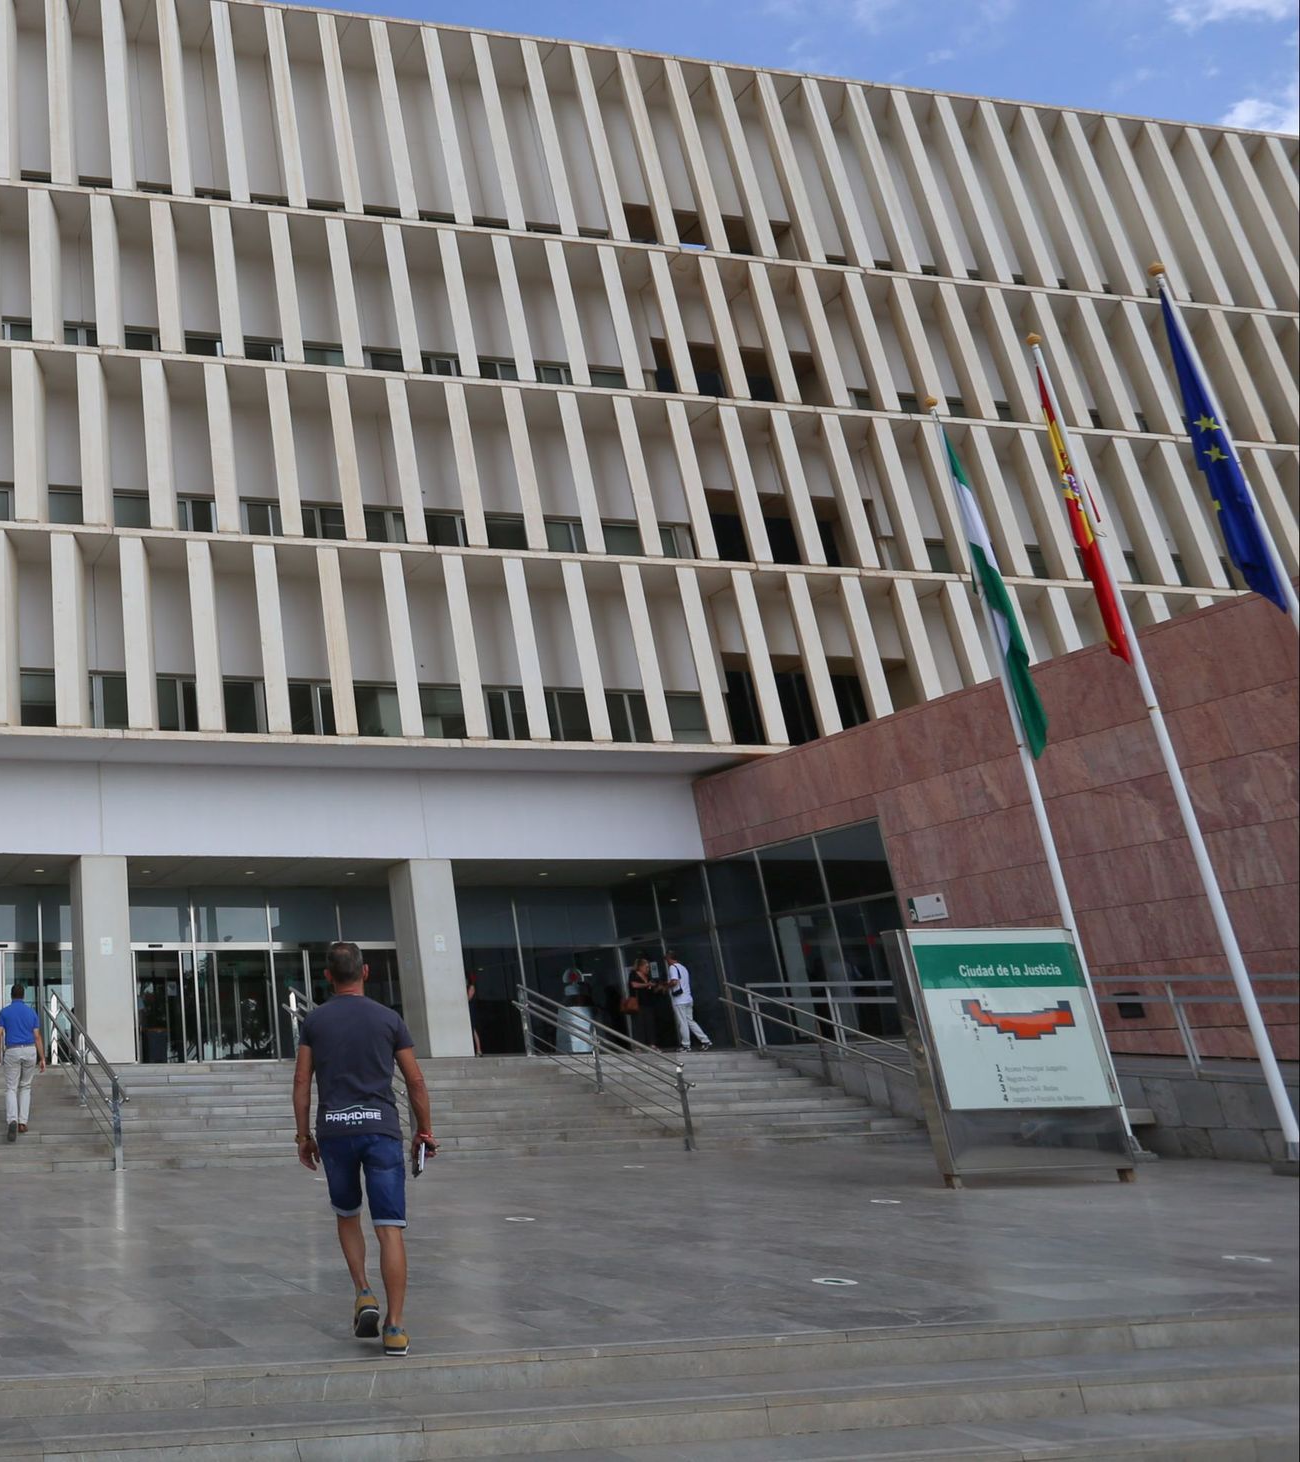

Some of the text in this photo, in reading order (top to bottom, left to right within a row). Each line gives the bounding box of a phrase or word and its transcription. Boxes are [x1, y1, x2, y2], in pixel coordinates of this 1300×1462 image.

[958, 963, 1062, 977] Ciudad de la Justicia
[995, 1064, 1001, 1072] 1
[998, 1074, 1004, 1082] 2
[1000, 1084, 1006, 1092] 3
